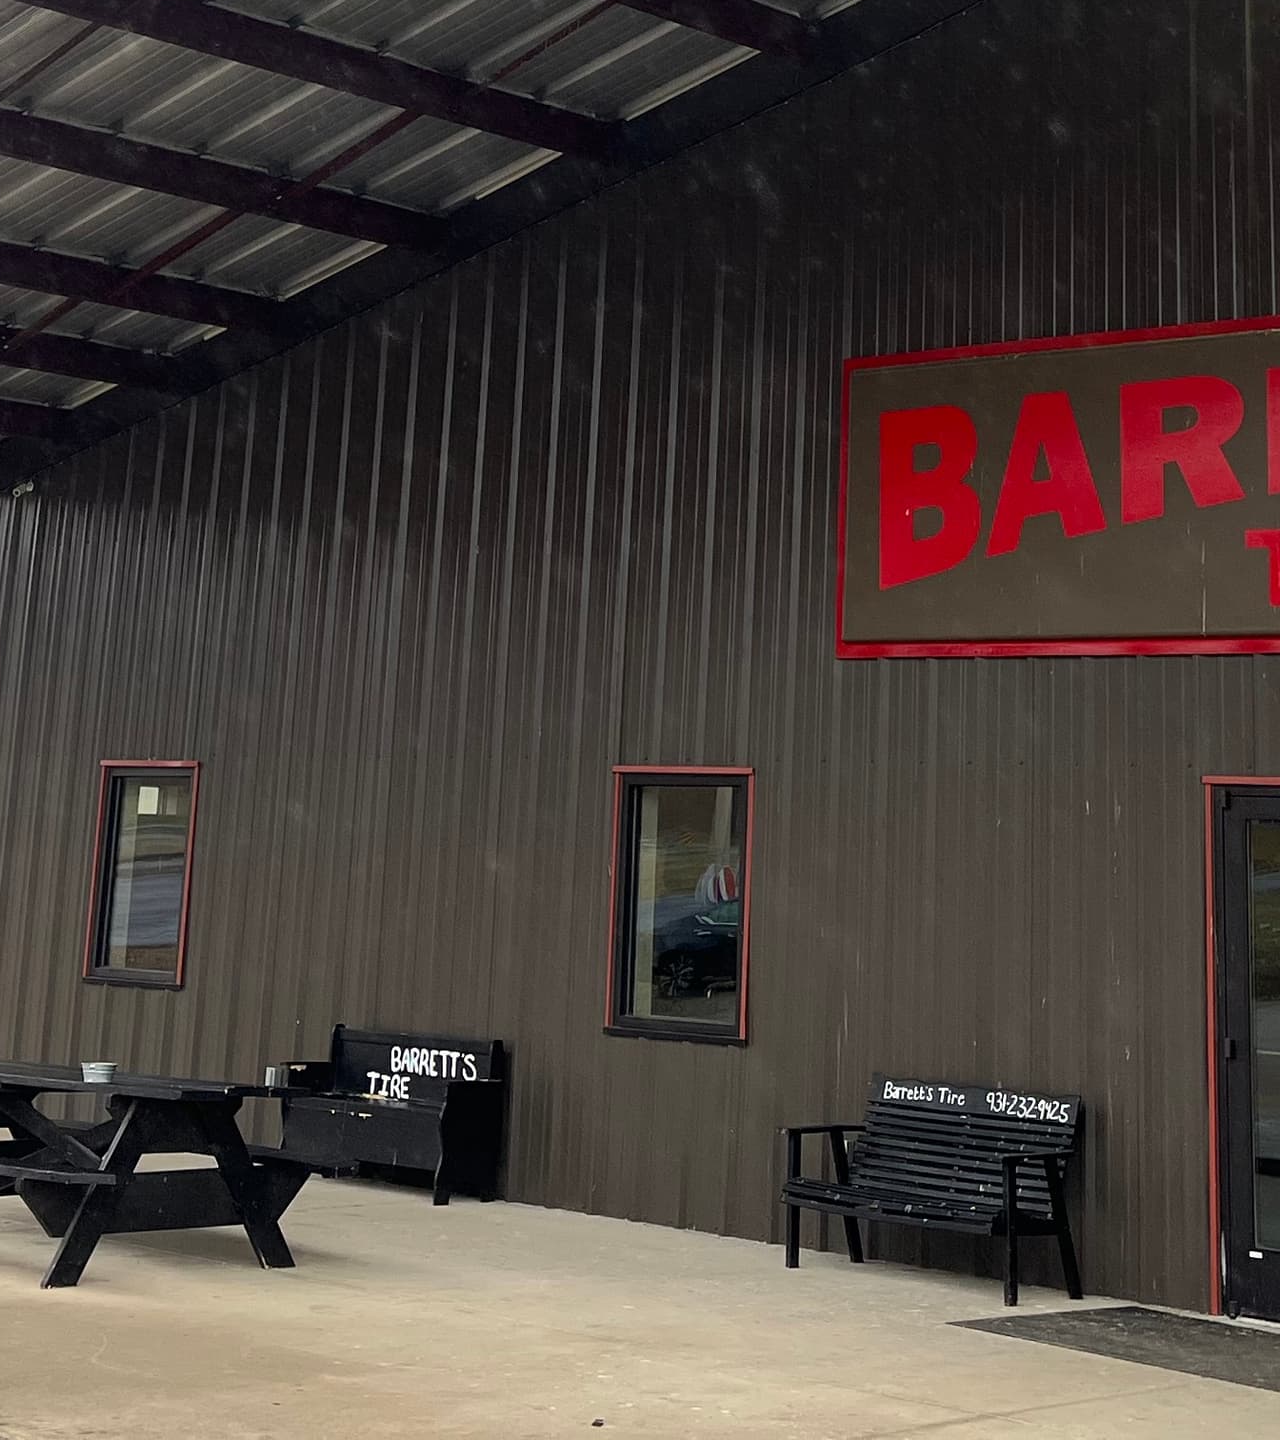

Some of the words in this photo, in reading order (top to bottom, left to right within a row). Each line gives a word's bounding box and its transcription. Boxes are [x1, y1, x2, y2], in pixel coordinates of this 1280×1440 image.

[391, 1046, 477, 1081] BARRETT'S
[366, 1071, 411, 1100] TIRE
[883, 1081, 933, 1102] Barrett's
[938, 1087, 966, 1106] Tire
